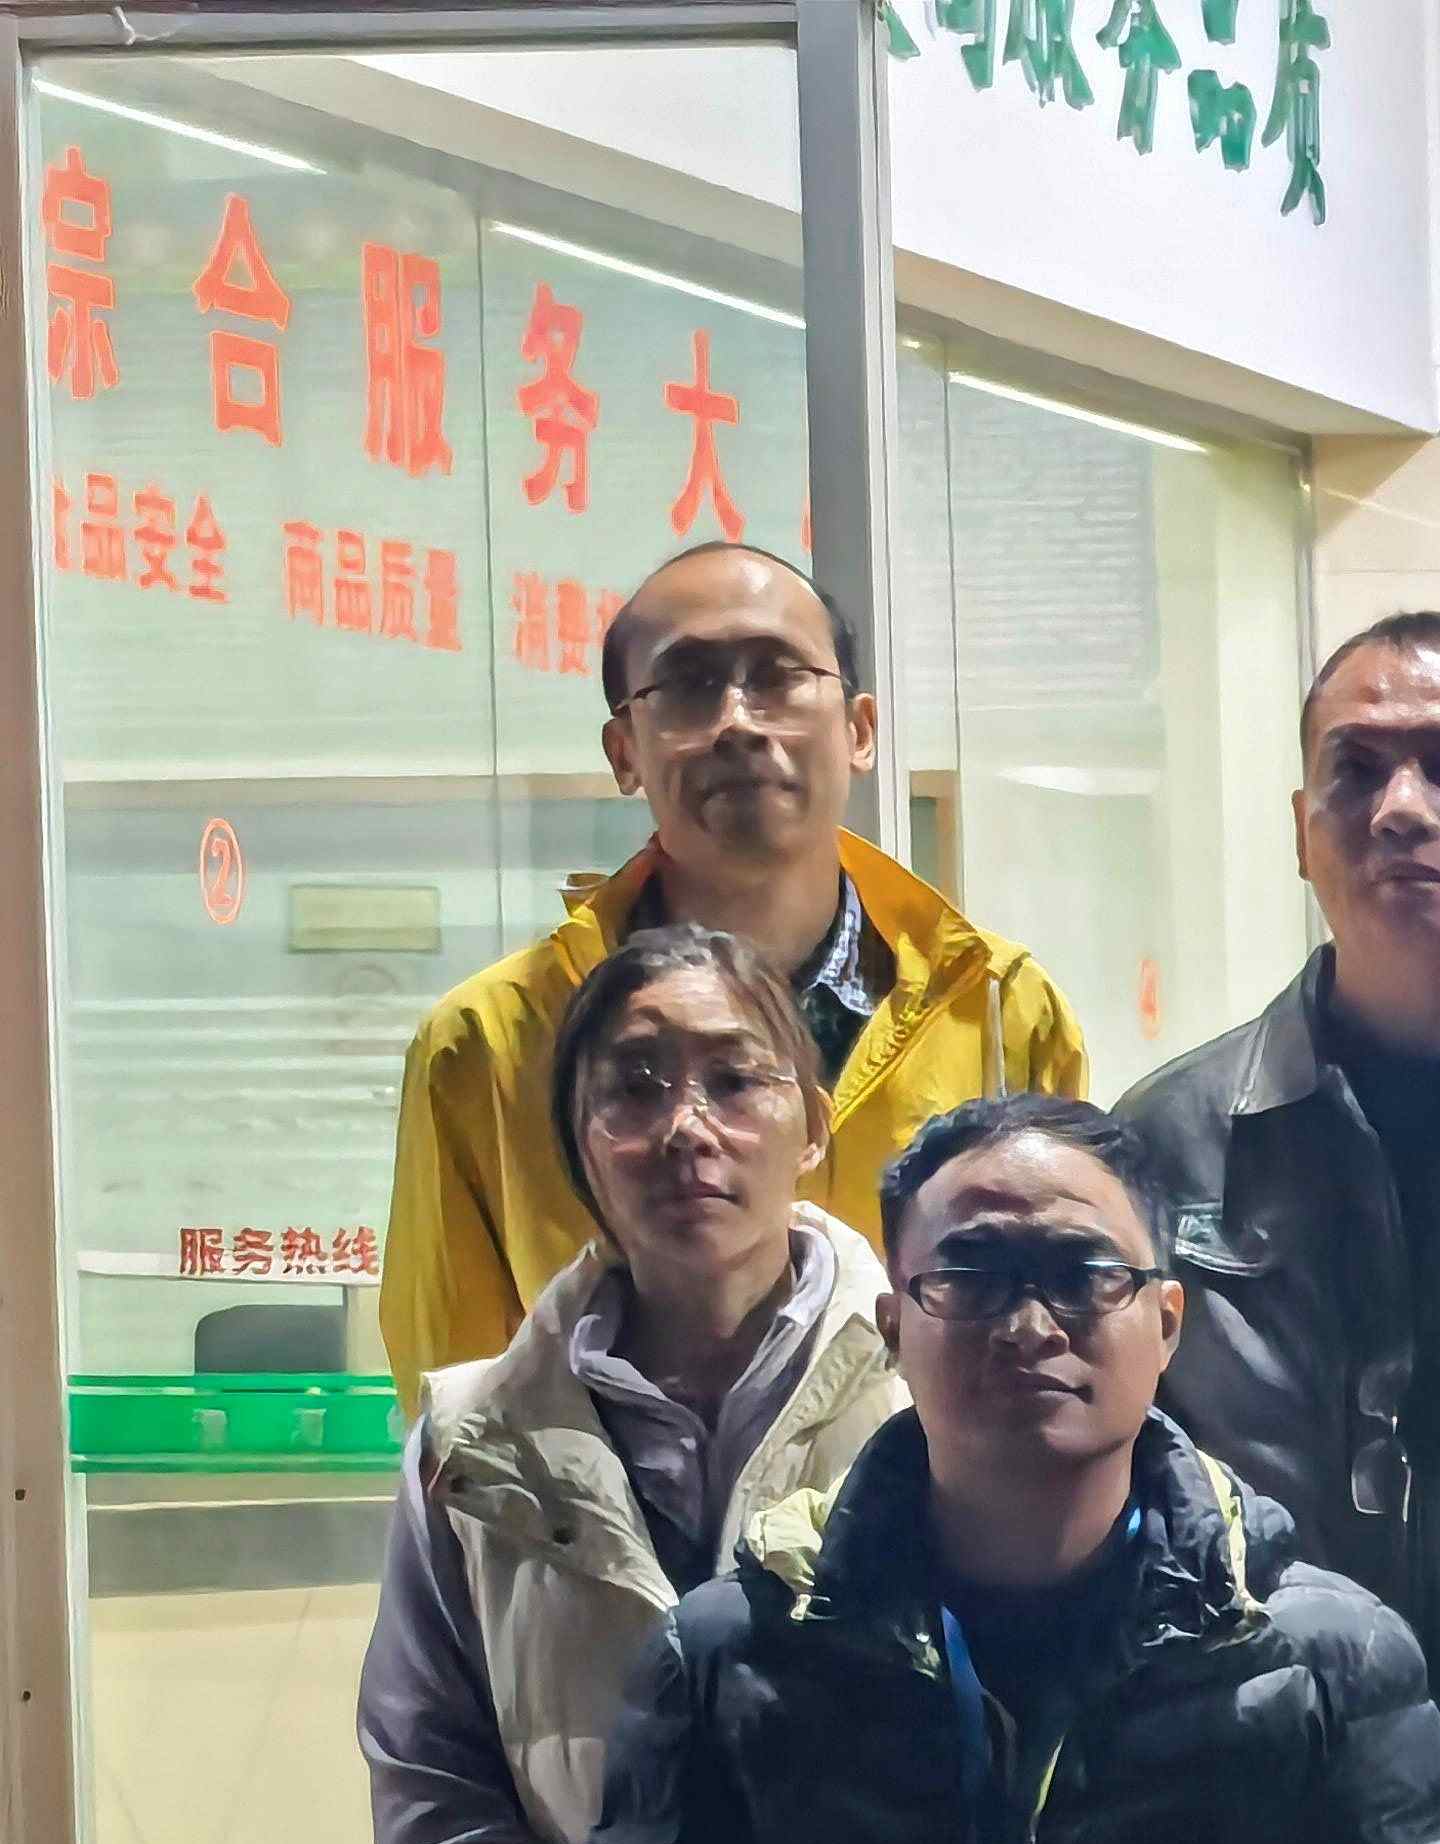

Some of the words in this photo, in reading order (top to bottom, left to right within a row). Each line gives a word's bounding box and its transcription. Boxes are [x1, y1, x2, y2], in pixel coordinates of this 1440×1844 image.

[42, 146, 813, 554] 综合服务大
[179, 1226, 380, 1276] 服务热线
